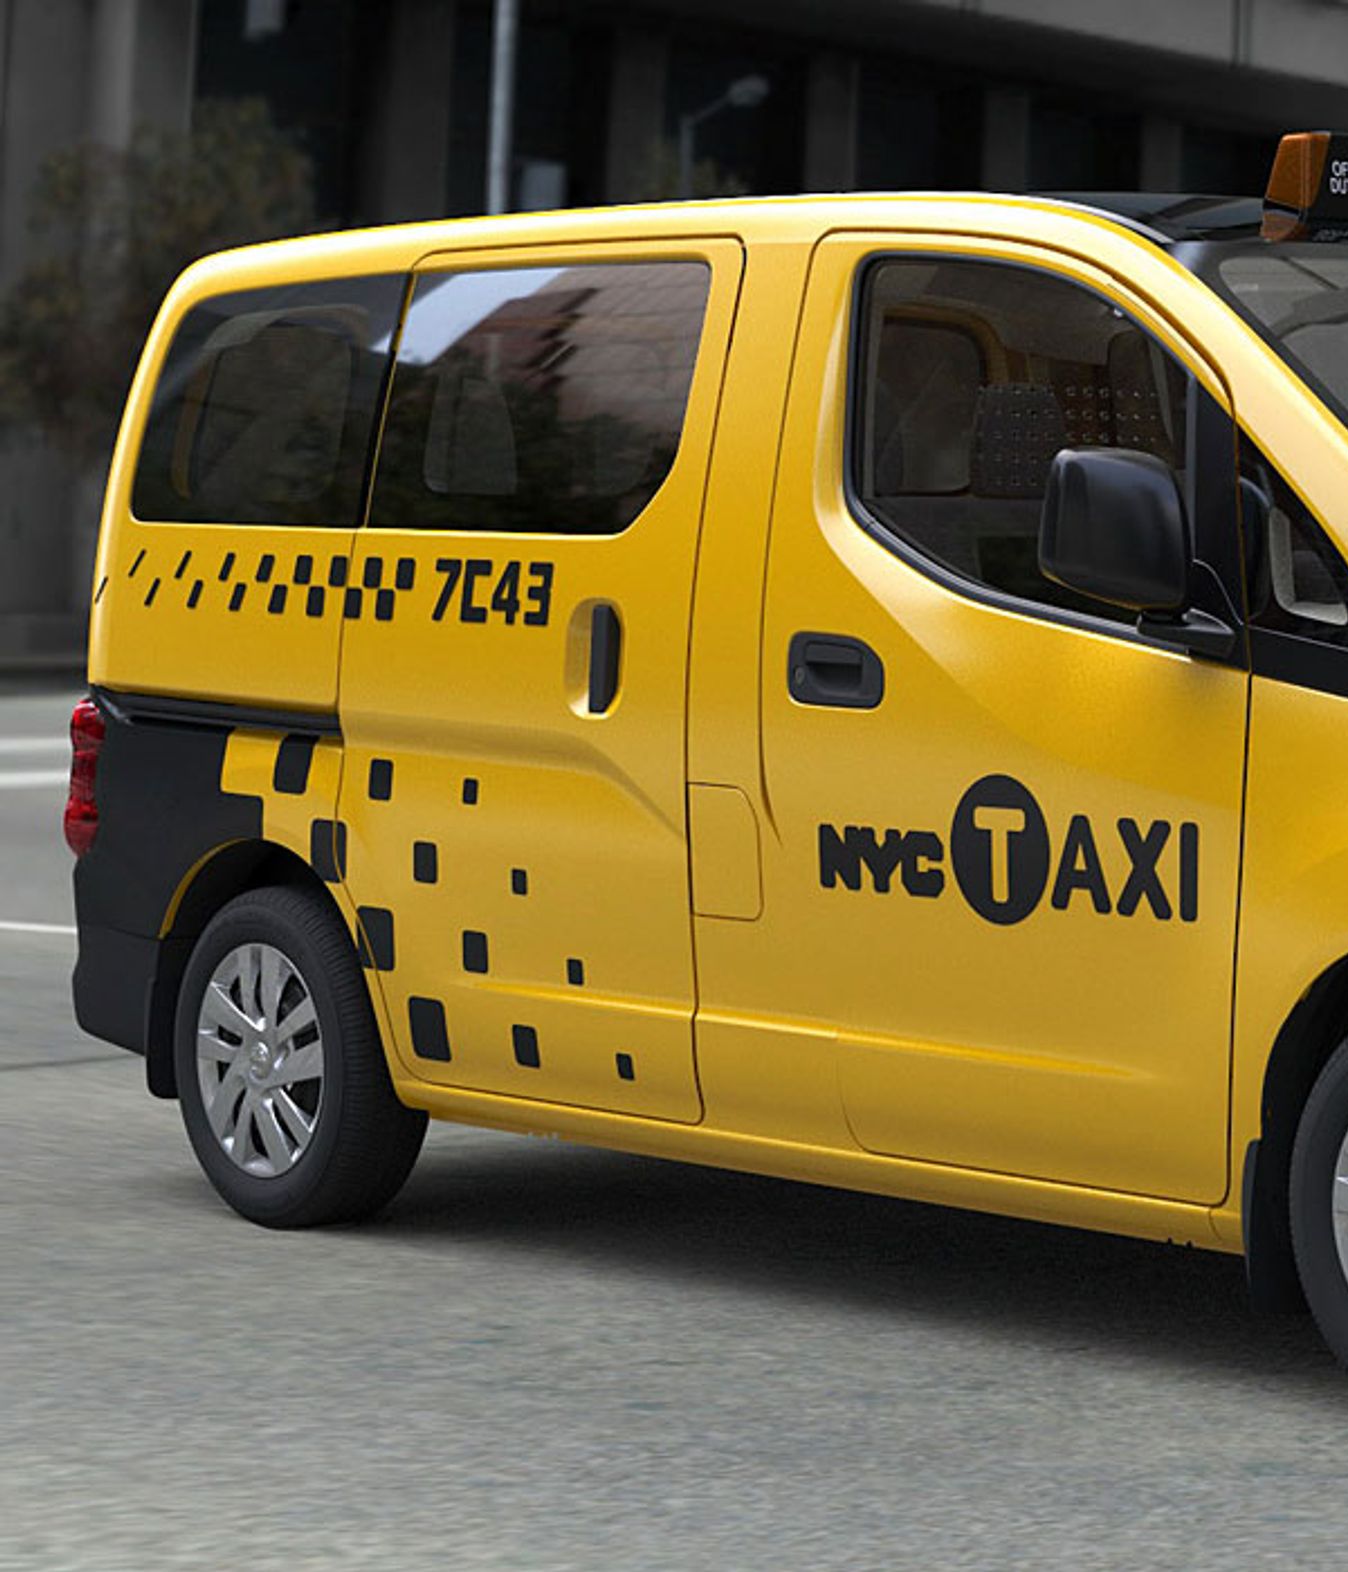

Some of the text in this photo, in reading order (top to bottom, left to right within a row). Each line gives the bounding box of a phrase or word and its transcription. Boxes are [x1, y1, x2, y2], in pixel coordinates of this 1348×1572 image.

[432, 558, 554, 626] 7C43
[818, 800, 1199, 922] NYC TAXI
